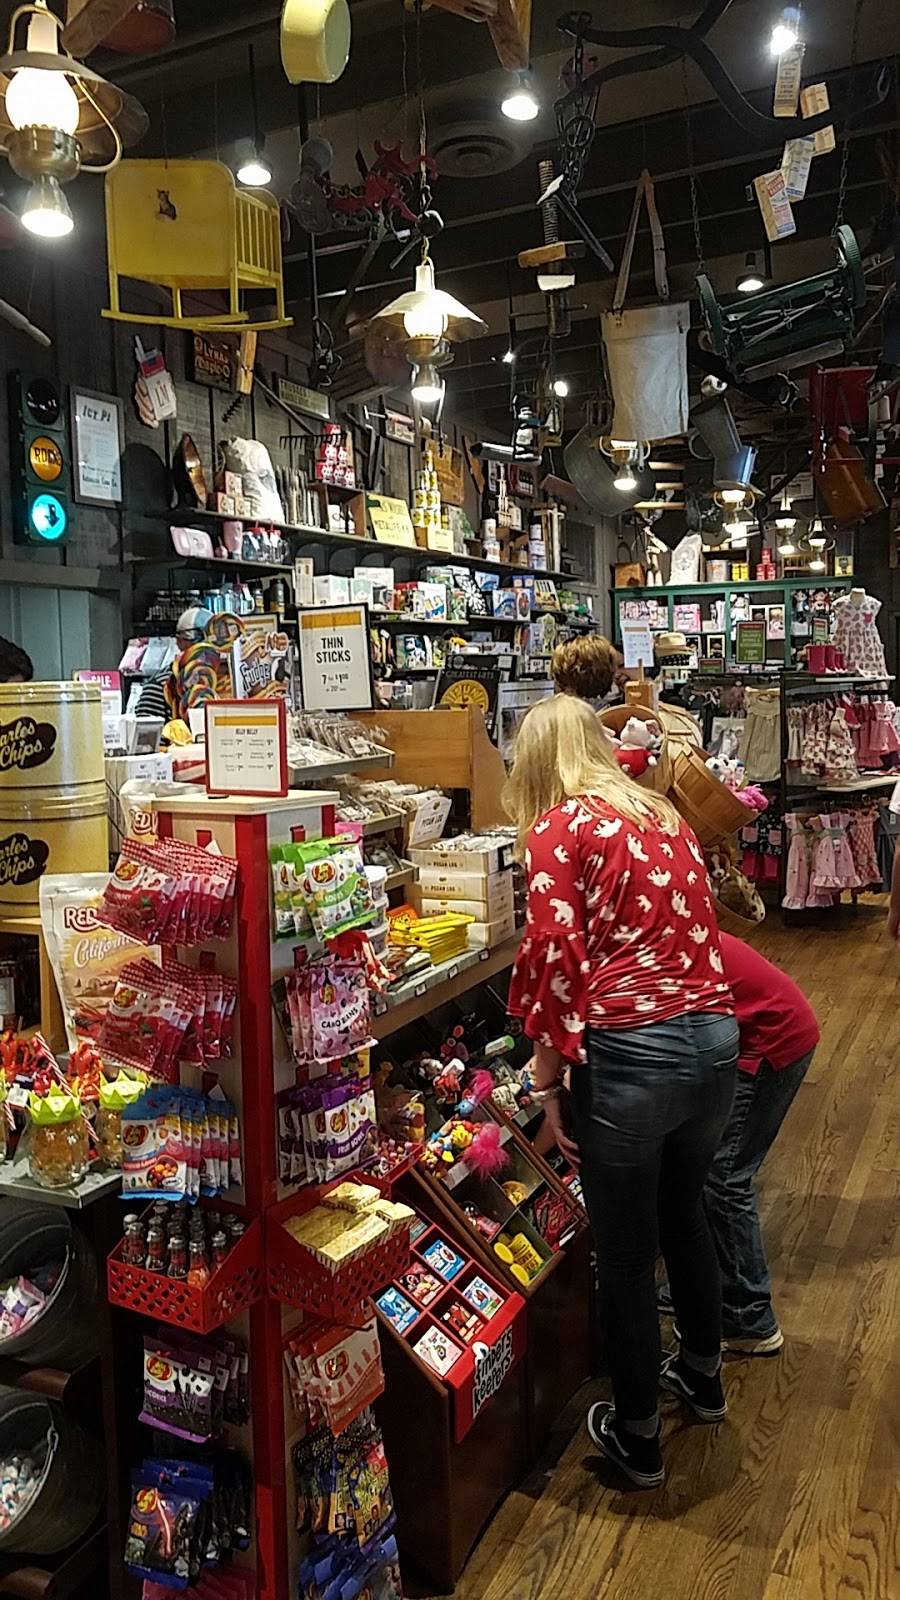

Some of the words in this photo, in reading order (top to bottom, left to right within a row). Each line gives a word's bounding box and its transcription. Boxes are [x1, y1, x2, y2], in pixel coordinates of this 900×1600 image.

[321, 637, 344, 649] THIN
[316, 650, 351, 663] STICKS
[322, 674, 327, 685] 7
[0, 739, 43, 768] Chips
